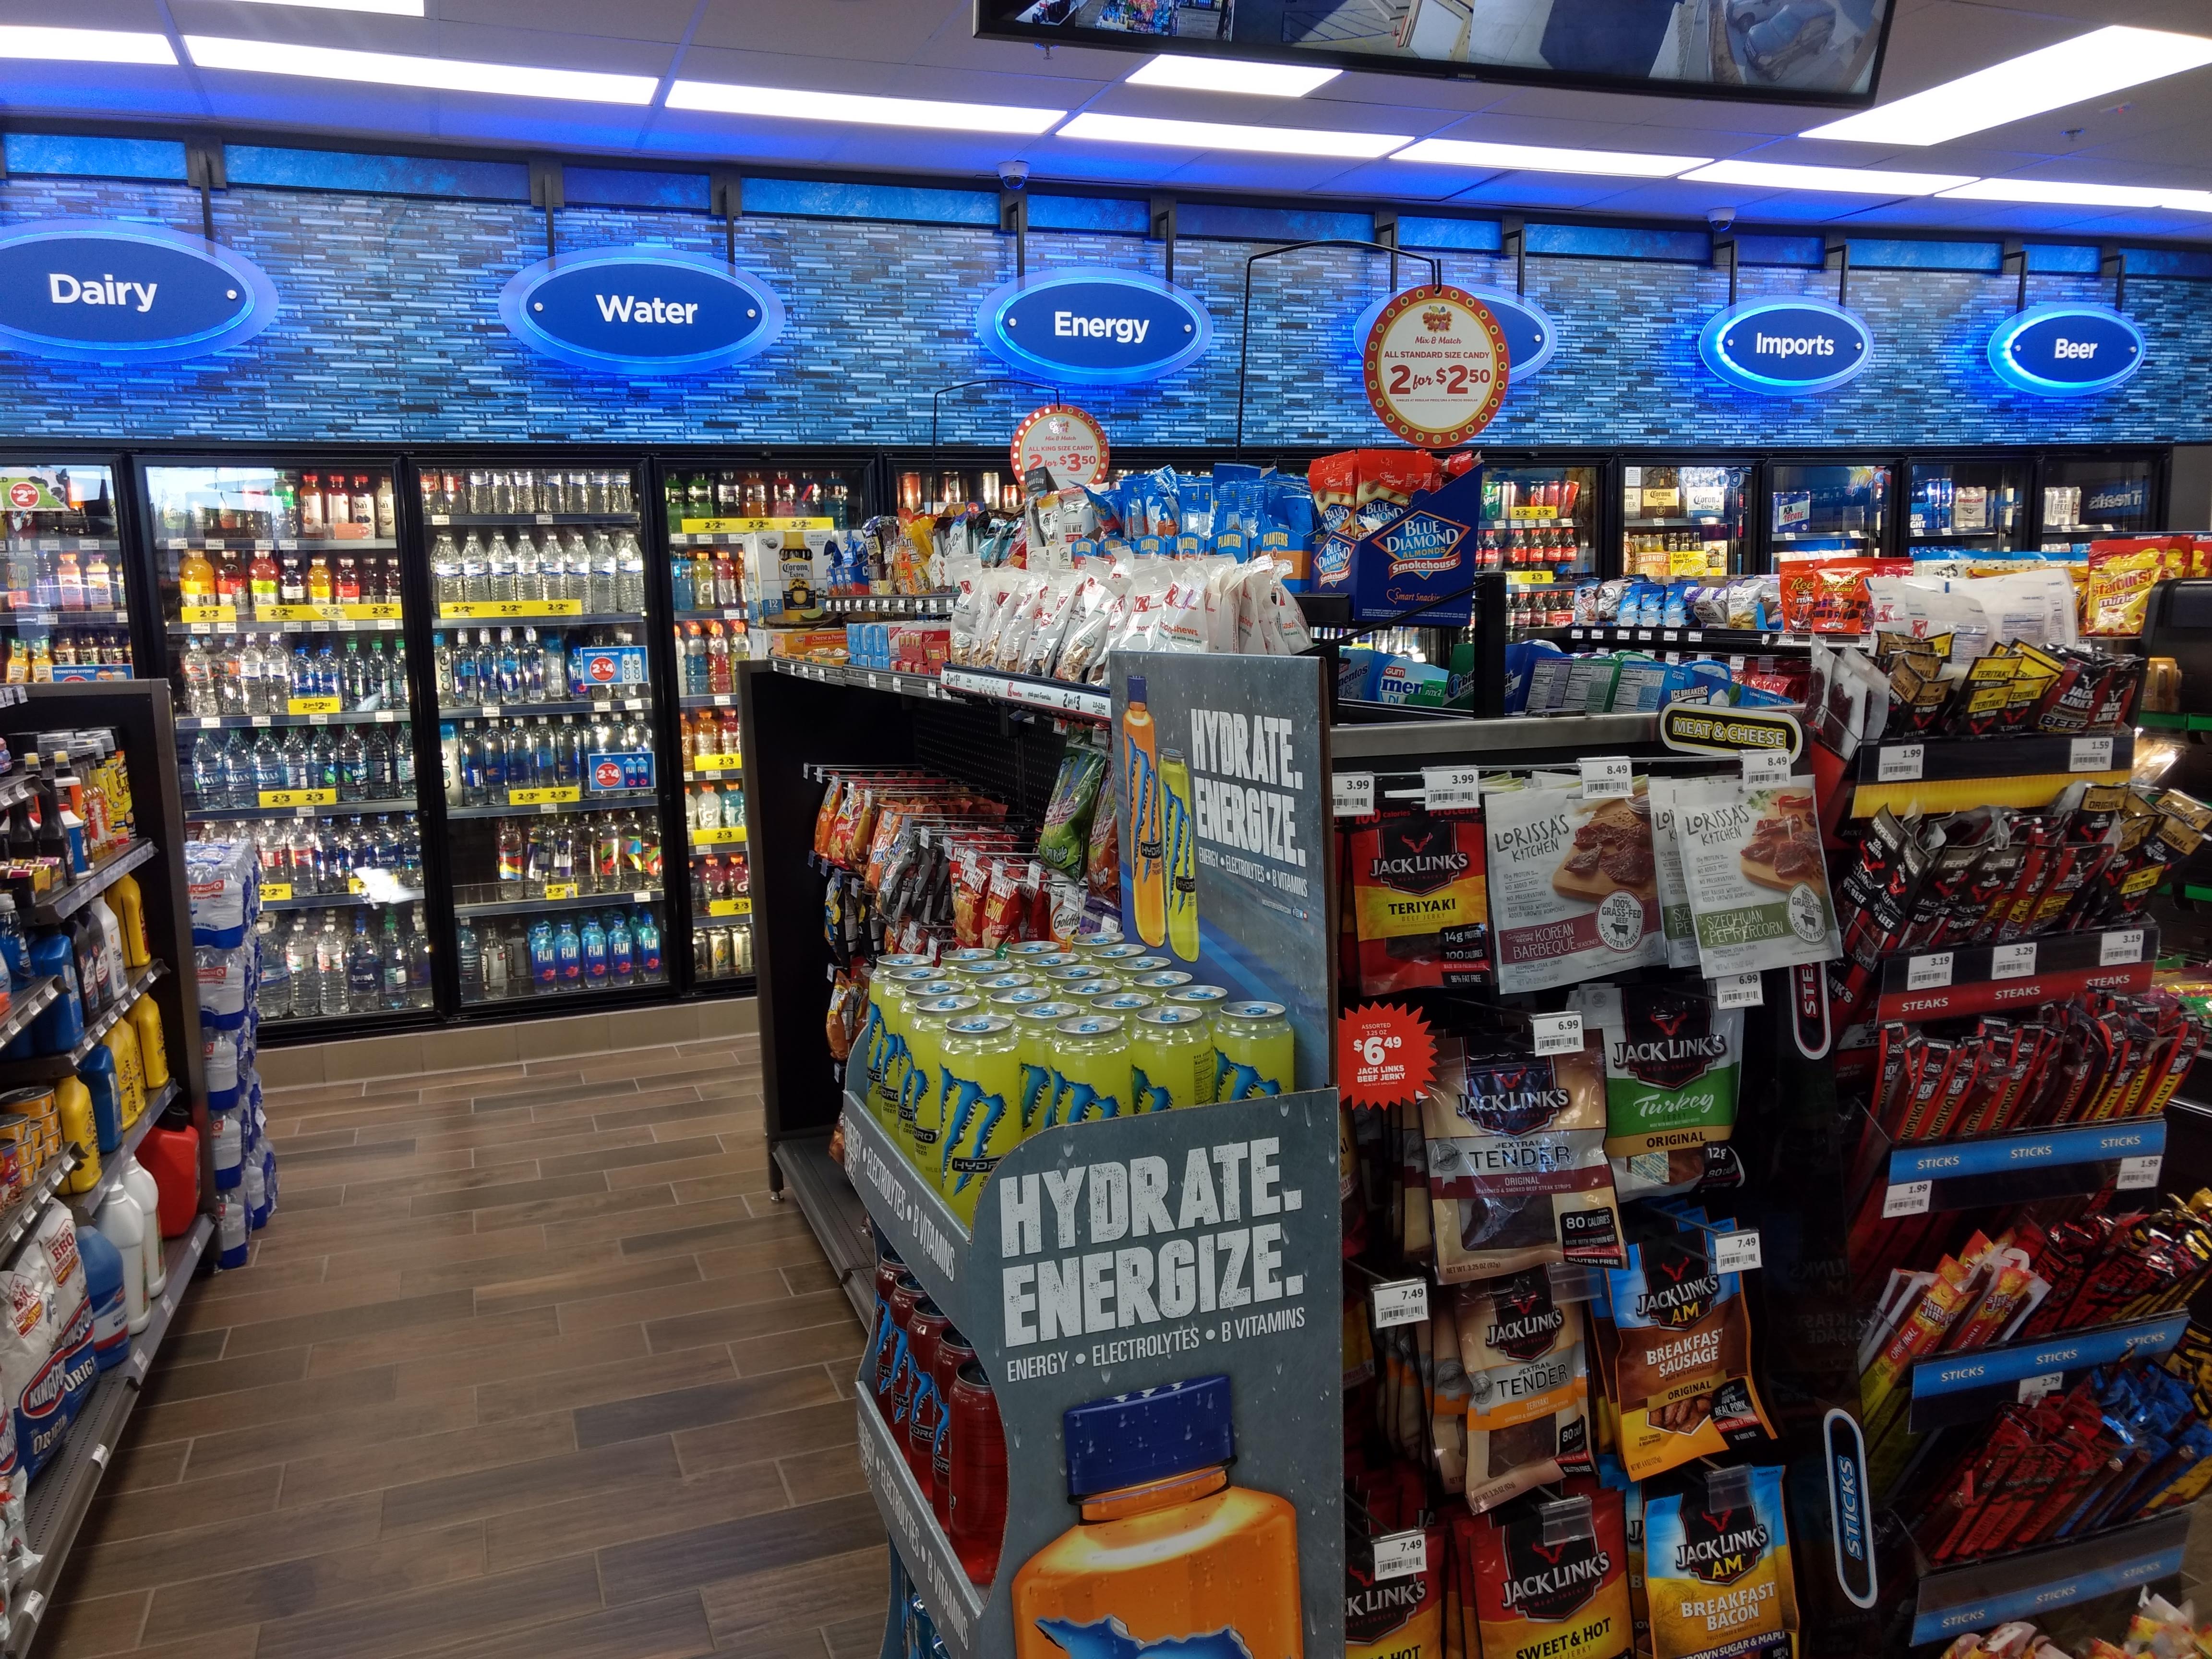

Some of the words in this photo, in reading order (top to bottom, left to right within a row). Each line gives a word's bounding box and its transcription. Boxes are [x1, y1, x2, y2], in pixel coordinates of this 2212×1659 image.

[49, 273, 157, 313] Dairy
[596, 295, 698, 324] Water
[1055, 311, 1150, 343] Energy
[1756, 332, 1835, 357] Imports
[2055, 338, 2097, 359] Beer
[1390, 365, 1410, 394] 2
[1413, 374, 1434, 390] for
[1694, 495, 1719, 504] Corona
[1366, 503, 1390, 514] BLUE
[1783, 511, 1804, 523] TECATE
[1406, 521, 1439, 537] BLUE
[1076, 542, 1092, 552] PLANTERS
[1218, 534, 1241, 548] PLANTERS
[1262, 534, 1288, 547] PLANTERS
[1387, 529, 1458, 553] DIAMOND
[1403, 546, 1445, 558] ALMONDS
[1392, 559, 1456, 573] Smokehouse
[769, 600, 778, 608] 12
[592, 664, 600, 673] 2
[1671, 690, 1680, 699] ICE
[1681, 686, 1707, 697] BREAKERS
[1974, 699, 2003, 709] TERIYAKI
[1674, 720, 1712, 737] MEAT
[1714, 722, 1725, 738] &
[1728, 724, 1785, 746] CHEESE
[1190, 709, 1302, 790] HYDRATE.
[2092, 741, 2109, 750] 1.59
[1902, 749, 1921, 758] 1.99
[1767, 757, 1787, 766] 8.49
[598, 770, 605, 779] 2
[1607, 765, 1628, 775] 8.49
[1346, 781, 1369, 790] 3.99
[1452, 774, 1474, 784] 3.99
[1195, 777, 1306, 867] ENERGIZE.
[1495, 814, 1570, 852] LORISSA'S
[1701, 827, 1742, 846] KITCHEN
[1513, 839, 1559, 862] KITCHEN
[1199, 846, 1218, 868] ENERGY
[1226, 857, 1264, 883] ELECTROLYTES
[1273, 871, 1277, 888] B
[1278, 874, 1308, 897] VITAMINS
[1370, 860, 1414, 877] JACK
[1417, 853, 1468, 871] LINK'S
[1515, 891, 1546, 900] PRESERVATIVES
[1388, 898, 1456, 914] TERIYAKI
[1613, 899, 1631, 909] 100%
[1602, 907, 1641, 918] GRASS-FED
[1707, 910, 1763, 929] SZECHUAN
[1444, 932, 1463, 942] 14g
[1465, 930, 1481, 939] PROTEIN
[1536, 923, 1574, 942] KOREAN
[1709, 921, 1783, 943] PEPPERCORN
[2123, 934, 2141, 943] 3.19
[1446, 950, 1464, 959] 100
[1465, 950, 1482, 959] CALORIES
[1513, 937, 1576, 959] BARBEQUE
[1577, 939, 1599, 948] SEASONED
[2015, 947, 2034, 956] 3.29
[1931, 956, 1949, 966] 3.19
[1739, 975, 1758, 984] 6.99
[2086, 974, 2130, 986] STEAKS
[1995, 986, 2040, 1000] STEAKS
[1902, 998, 1948, 1012] STEAKS
[1558, 1020, 1578, 1030] 6.99
[1358, 1066, 1378, 1074] JACK
[1380, 1065, 1404, 1073] LINKS
[1380, 1072, 1406, 1081] JERKY
[1633, 1093, 1715, 1117] Turkey
[1647, 1131, 1706, 1148] ORIGINAL
[2101, 1136, 2140, 1148] STICKS
[2011, 1146, 2052, 1159] STICKS
[1917, 1156, 1960, 1169] STICKS
[2141, 1159, 2158, 1168] 1.99
[1504, 1177, 1539, 1186] ORIGINAL
[1909, 1184, 1927, 1194] 1.99
[999, 1137, 1302, 1258] HYDRATE.
[1566, 1217, 1585, 1229] 80
[1587, 1214, 1610, 1227] CALORIES
[1737, 1238, 1756, 1248] 7.49
[1003, 1223, 1304, 1347] ENERGIZE.
[1402, 1288, 1423, 1300] 7.49
[1007, 1351, 1068, 1382] ENERGY
[1092, 1328, 1200, 1367] ELECTROLYTES
[1222, 1322, 1231, 1342] B
[1236, 1307, 1305, 1339] VITAMINS
[1646, 1328, 1723, 1366] BREAKFAST
[1659, 1346, 1719, 1378] SAUSAGE
[2036, 1349, 2078, 1364] STICKS
[1941, 1367, 1984, 1382] STICKS
[1668, 1381, 1712, 1400] ORIGINAL
[1400, 1539, 1422, 1551] 7.49
[1681, 1582, 1775, 1618] BREAKFAST
[1707, 1603, 1759, 1631] BACON
[1942, 1610, 1984, 1627] STICKS
